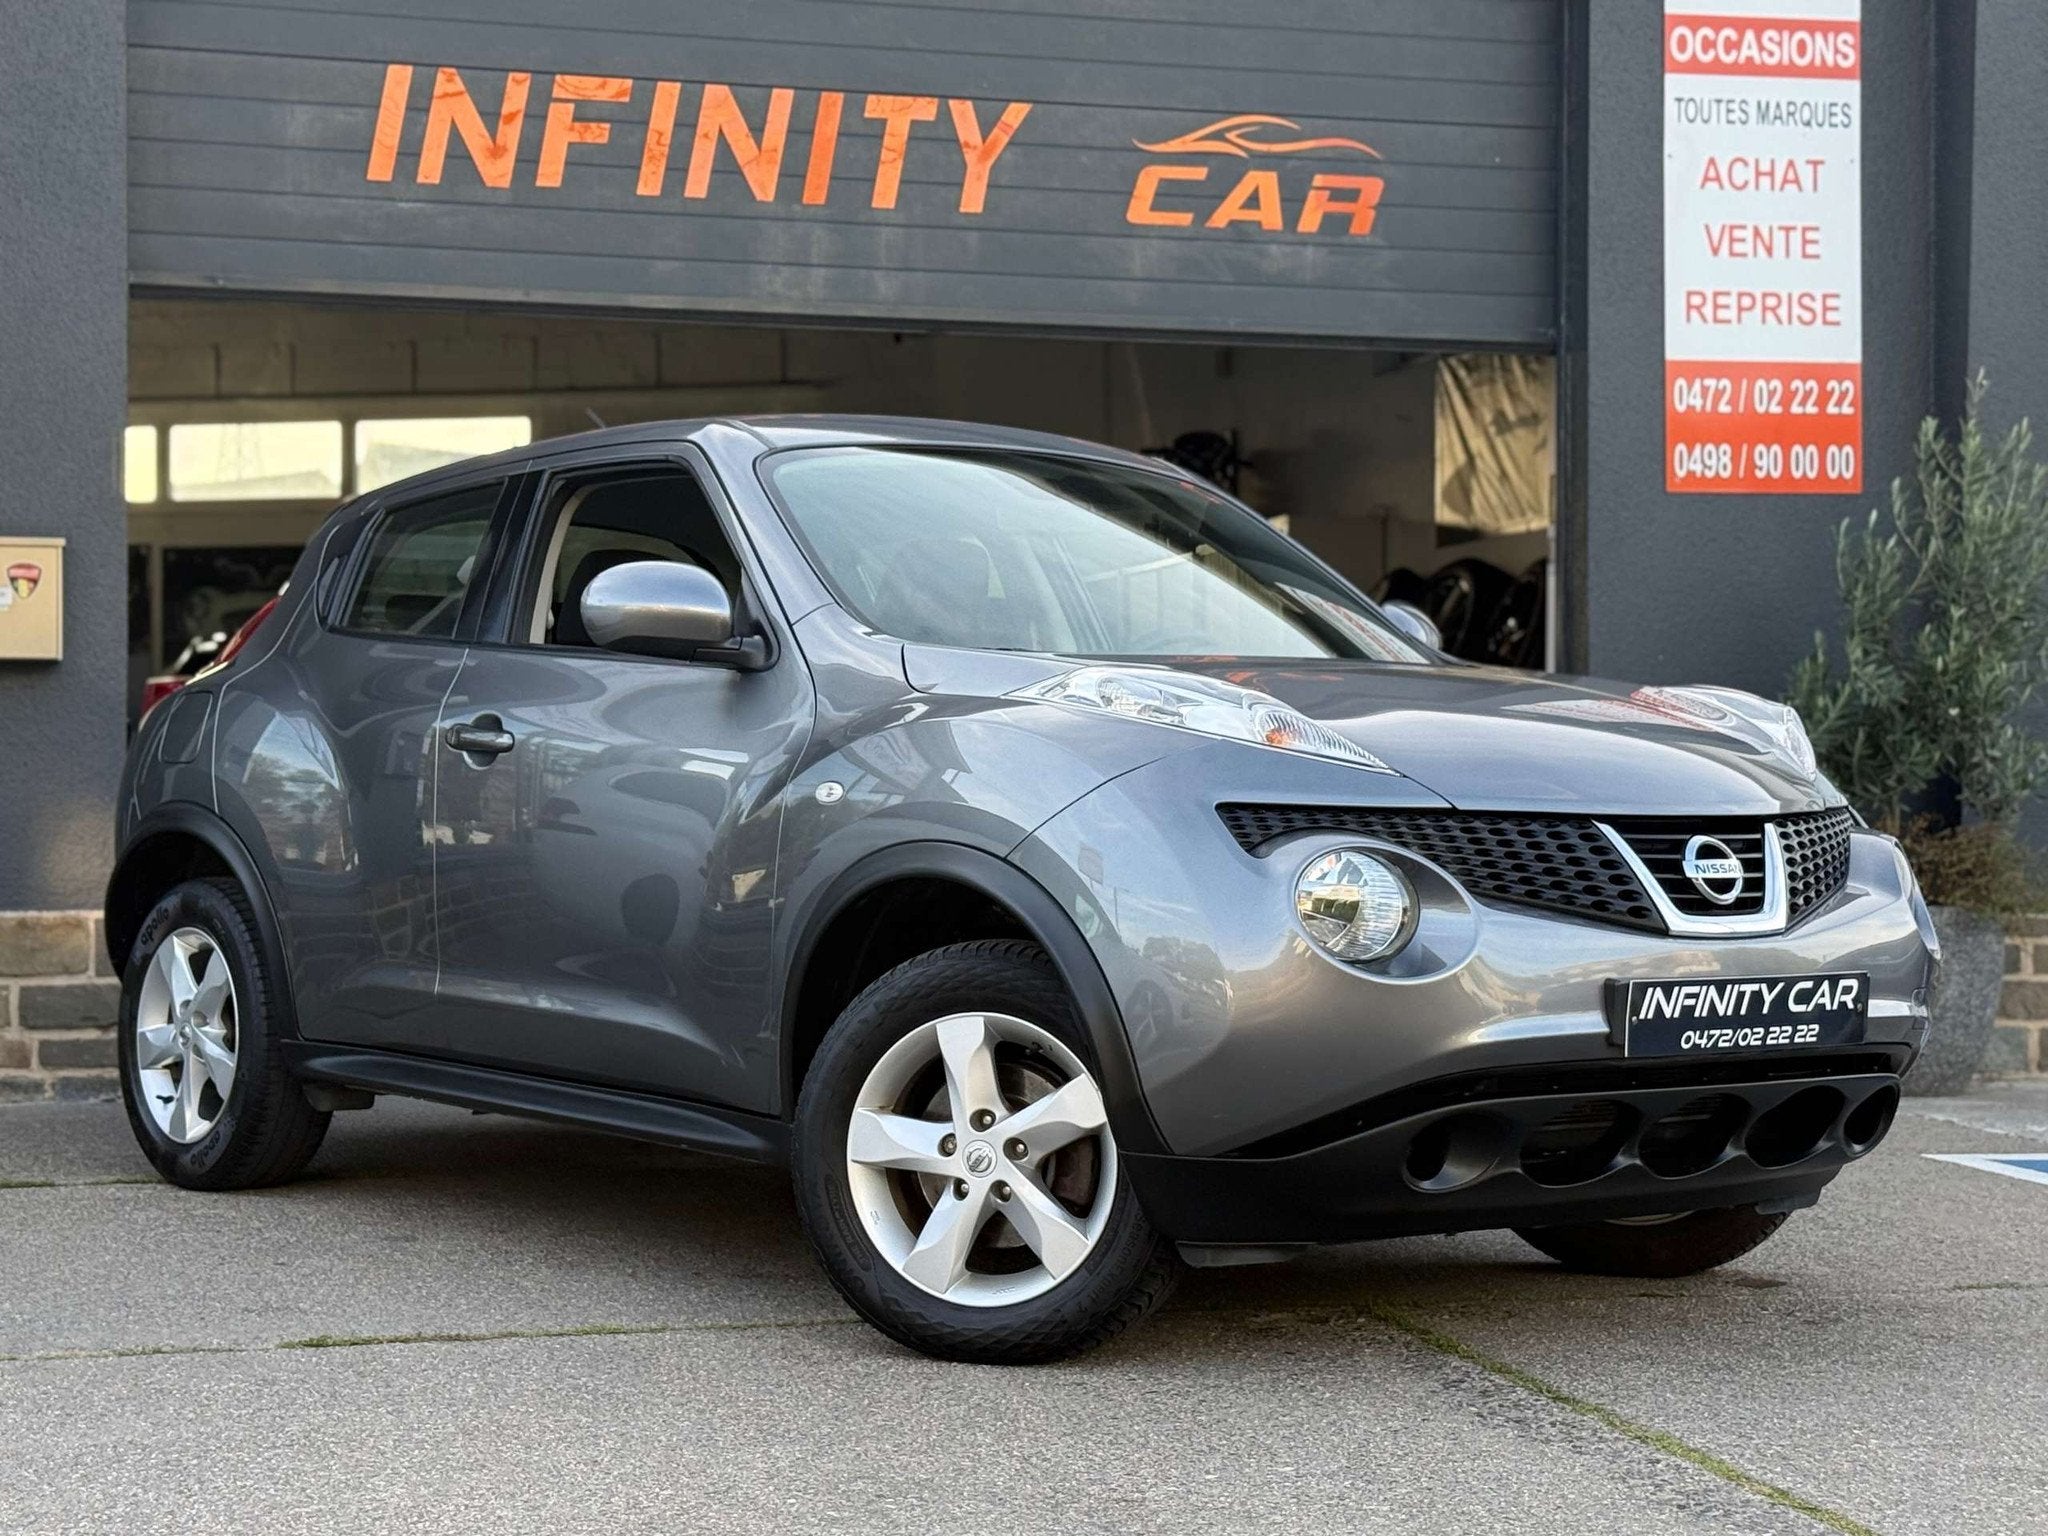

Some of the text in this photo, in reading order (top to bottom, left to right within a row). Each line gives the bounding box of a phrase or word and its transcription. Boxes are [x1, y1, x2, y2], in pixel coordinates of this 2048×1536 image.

[1669, 25, 1856, 69] OCCASIONS
[1674, 97, 1852, 129] TOUTES MARQUES
[366, 64, 1386, 237] INFINITY CAR
[1699, 156, 1825, 193] ACHAT
[1703, 223, 1821, 260] VENTE
[1685, 290, 1842, 327] REPRISE
[1673, 376, 1733, 414] 0472
[1753, 377, 1783, 415] 02
[1789, 378, 1819, 415] 22
[1826, 379, 1856, 415] 22
[1673, 442, 1733, 479] 0498
[1753, 443, 1783, 480] 90
[1790, 443, 1819, 480] 00
[1826, 444, 1856, 480] 00
[1639, 978, 1859, 1020] INFINITY CAR
[1680, 1024, 1820, 1050] 0472/02 22 22
